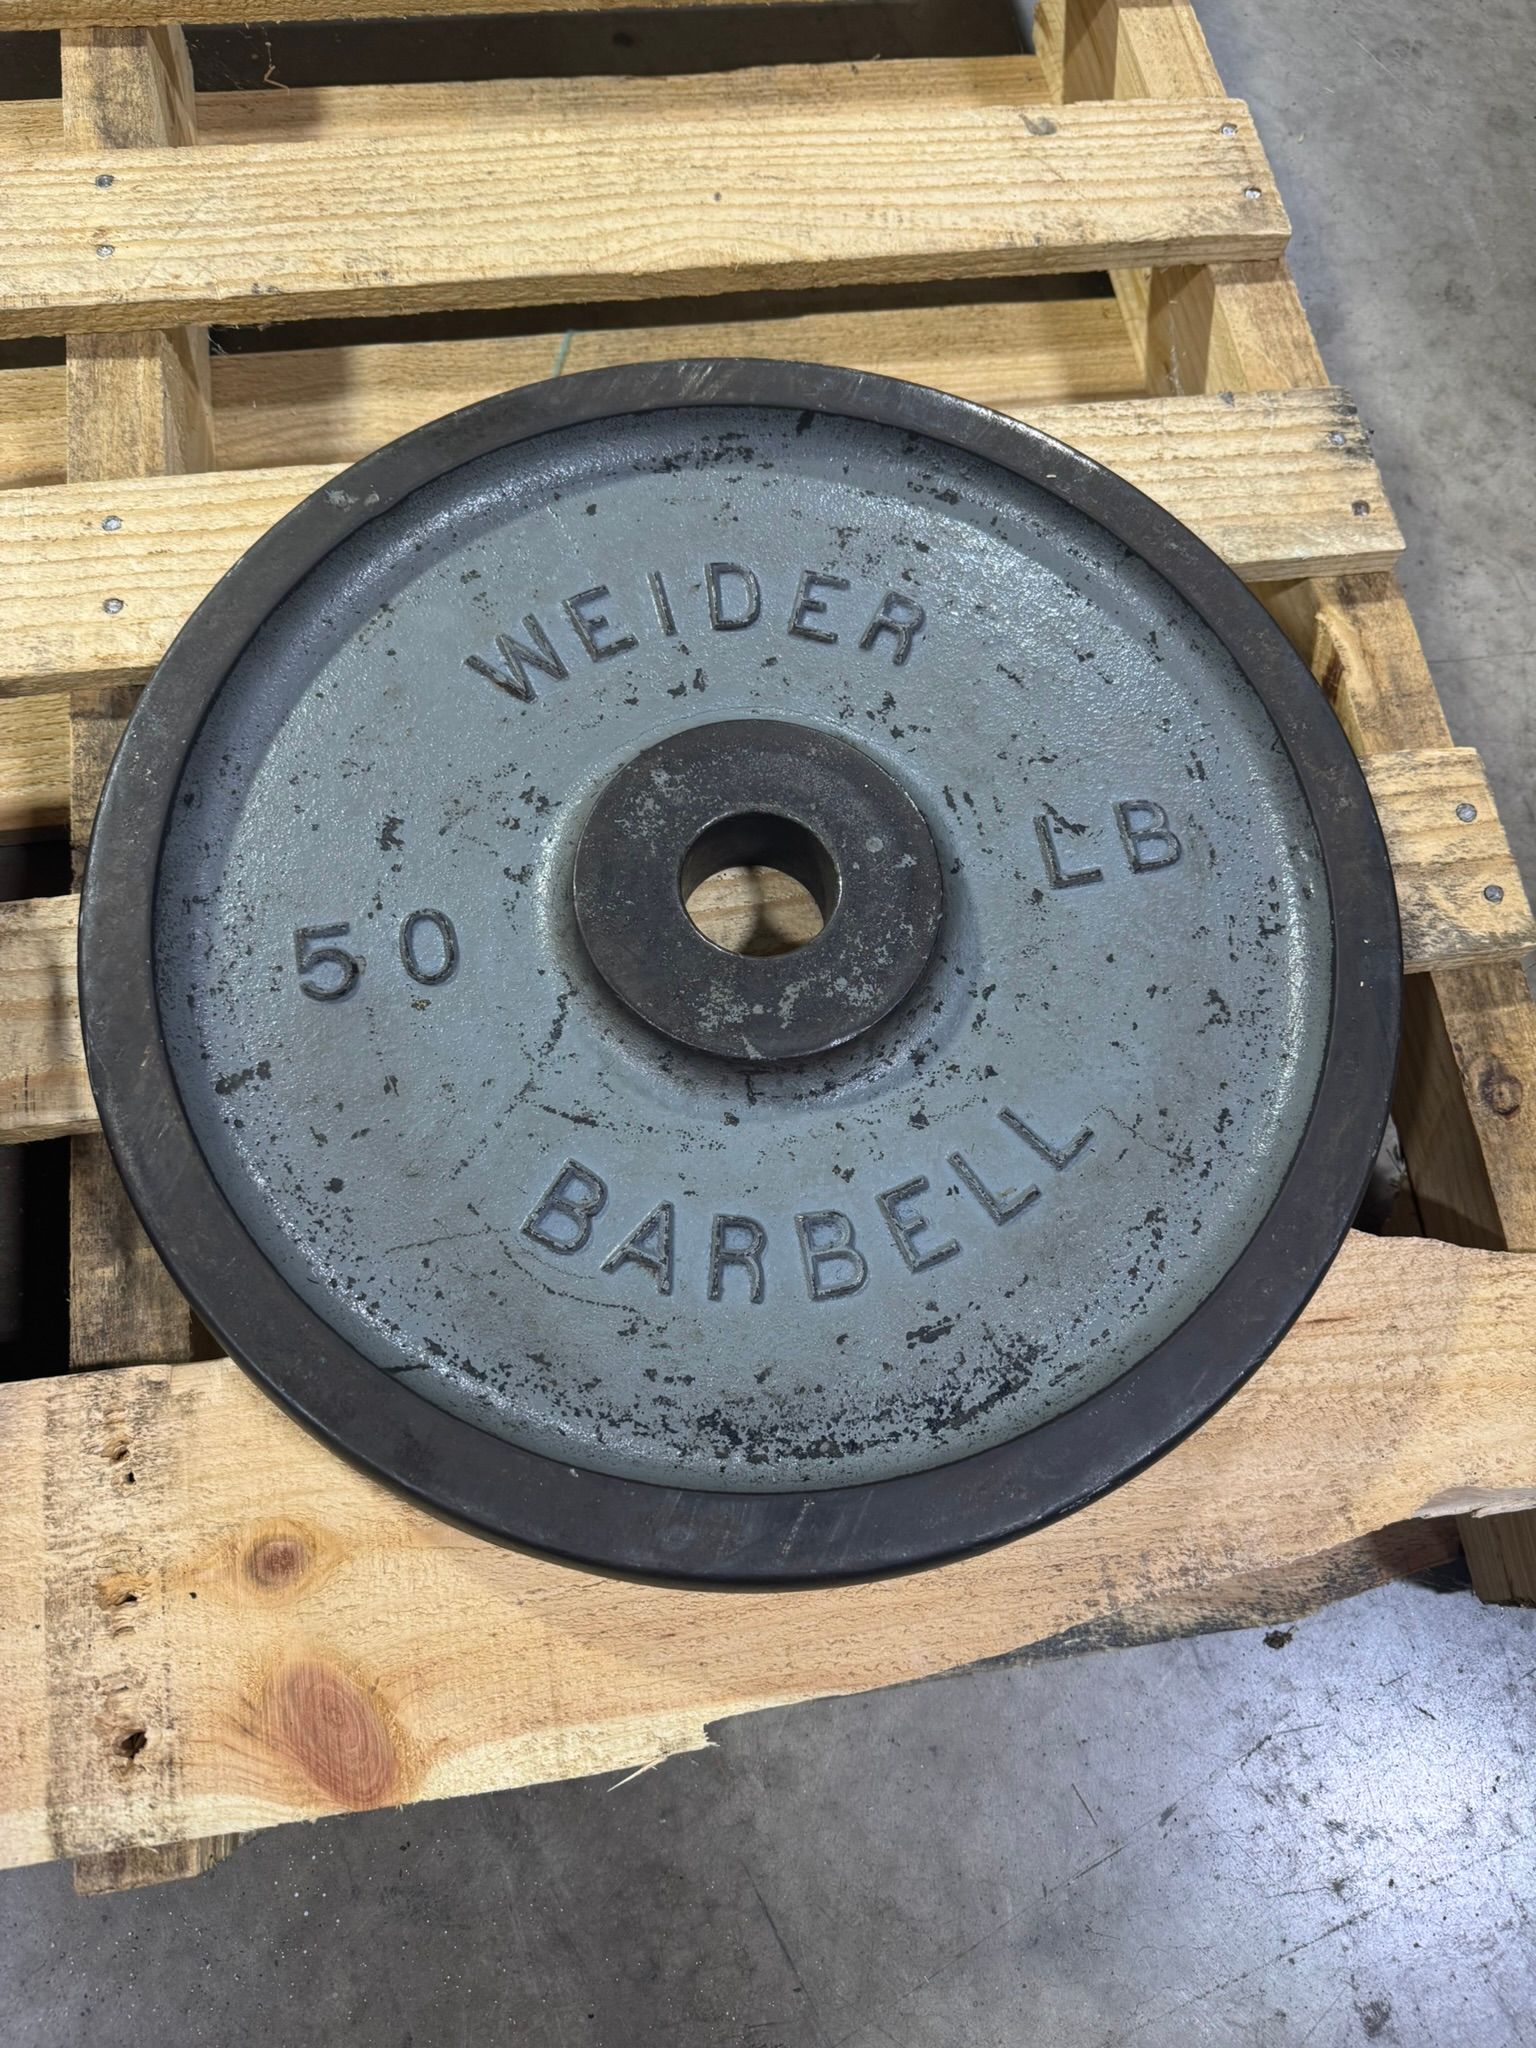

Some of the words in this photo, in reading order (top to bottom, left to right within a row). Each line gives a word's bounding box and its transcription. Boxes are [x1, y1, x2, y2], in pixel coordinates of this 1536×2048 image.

[463, 561, 926, 701] WEIDER
[1033, 799, 1182, 889] LB
[294, 908, 459, 1003] 50
[519, 1106, 1094, 1303] BARBELL
